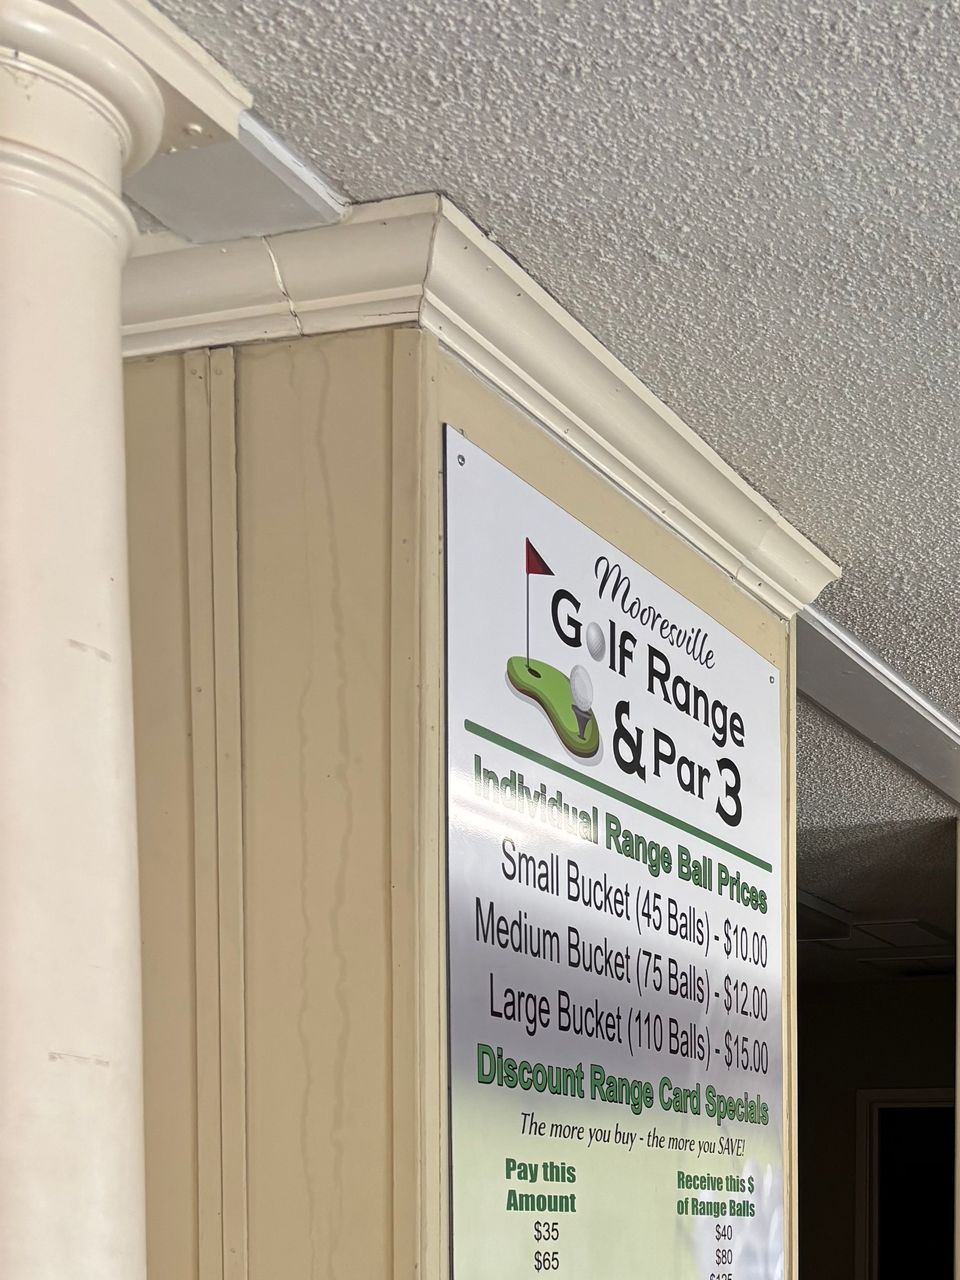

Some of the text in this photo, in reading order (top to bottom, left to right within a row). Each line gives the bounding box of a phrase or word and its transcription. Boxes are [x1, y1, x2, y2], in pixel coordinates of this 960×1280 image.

[595, 556, 715, 670] Mooresville
[550, 588, 745, 748] Golf Range
[612, 700, 743, 827] & Par 3
[473, 753, 768, 914] Individual Range Ball Prices
[501, 837, 559, 897] Small
[567, 858, 630, 921] Bucket
[635, 885, 662, 935] (45
[667, 897, 710, 957] Balls)
[723, 917, 768, 968] $10.00
[475, 896, 560, 964] Medium
[567, 926, 631, 984] Bucket
[636, 948, 662, 997] (75
[668, 958, 710, 1015] Balls)
[723, 973, 768, 1022] $12.00
[489, 972, 551, 1037] Large
[558, 989, 622, 1044] Bucket
[627, 1007, 663, 1057] (110
[669, 1017, 711, 1072] Balls)
[723, 1029, 768, 1075] $15.00
[476, 1042, 769, 1126] Discount Range Card Specials
[521, 1112, 546, 1137] The
[550, 1123, 584, 1140] more
[587, 1126, 611, 1148] you
[614, 1122, 637, 1151] buy
[647, 1127, 666, 1148] the
[668, 1134, 695, 1152] more
[698, 1139, 716, 1161] you
[717, 1137, 745, 1157] SAVE!
[505, 1157, 577, 1184] Pay this
[677, 1171, 755, 1194] Receive this $
[506, 1189, 577, 1212] Amount
[676, 1197, 755, 1218] of Range Balls
[534, 1221, 560, 1242] $35
[715, 1224, 733, 1242] $40
[534, 1251, 560, 1272] $65
[715, 1248, 733, 1266] $80
